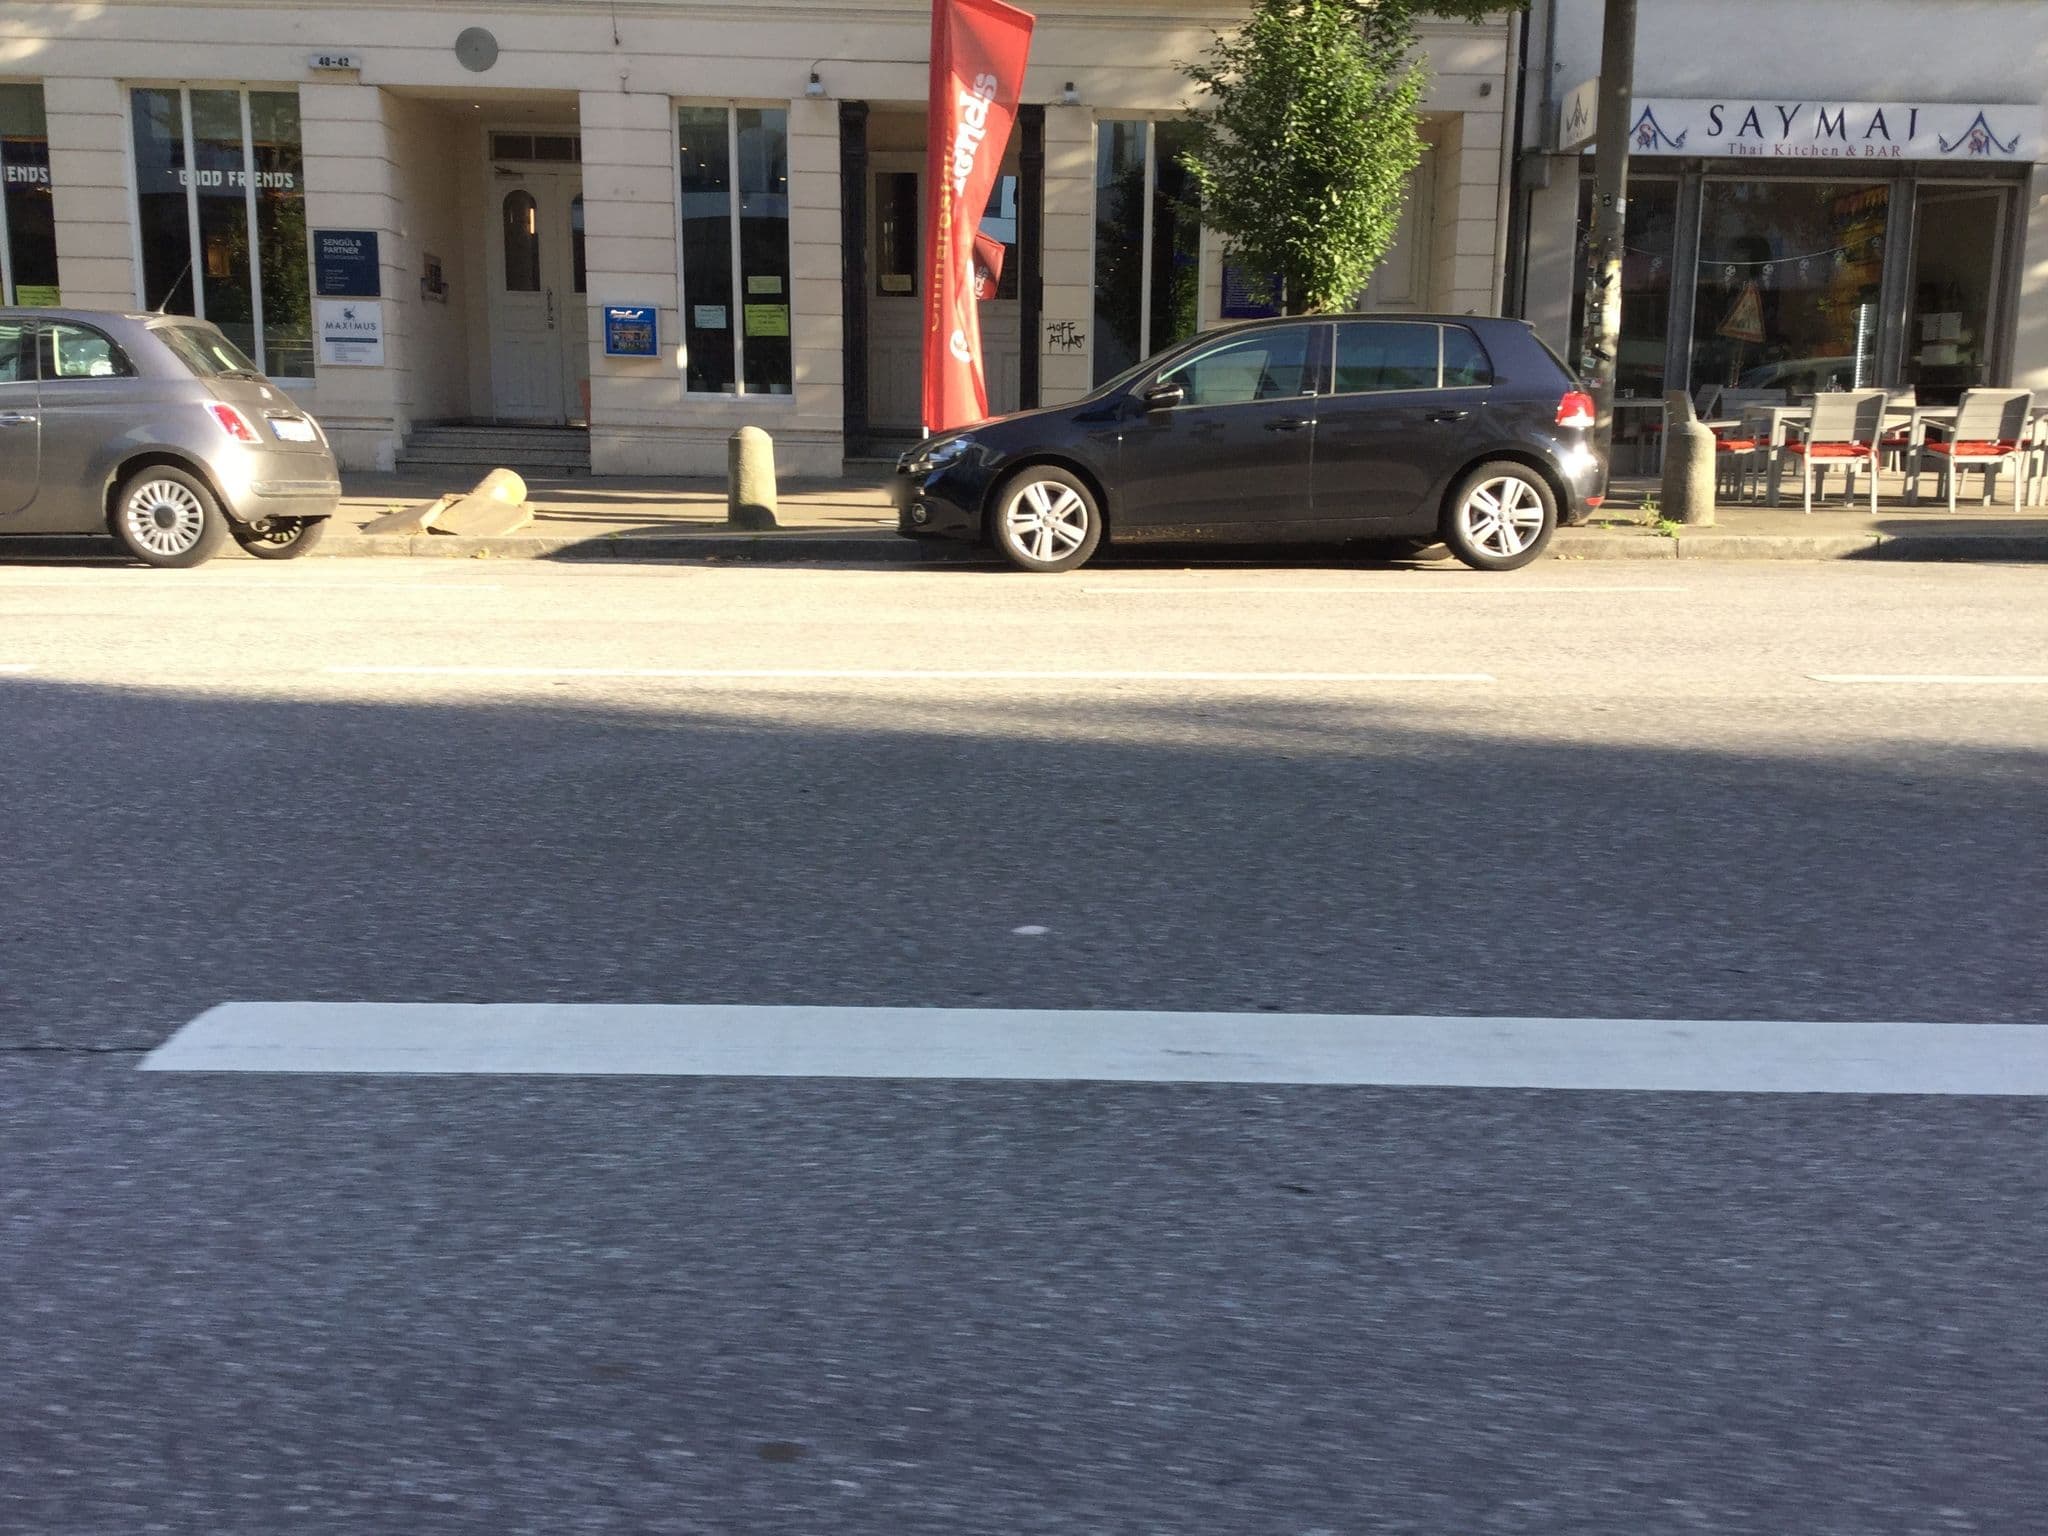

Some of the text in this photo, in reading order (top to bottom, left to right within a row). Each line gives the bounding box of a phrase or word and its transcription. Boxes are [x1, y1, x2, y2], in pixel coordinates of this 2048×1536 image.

[1707, 103, 1920, 142] SAYMAI
[1727, 142, 1905, 158] Thai Kitchen & BAR
[226, 170, 295, 188] FRENDS
[323, 246, 360, 255] PARTNER
[325, 320, 377, 331] MAXIMUS
